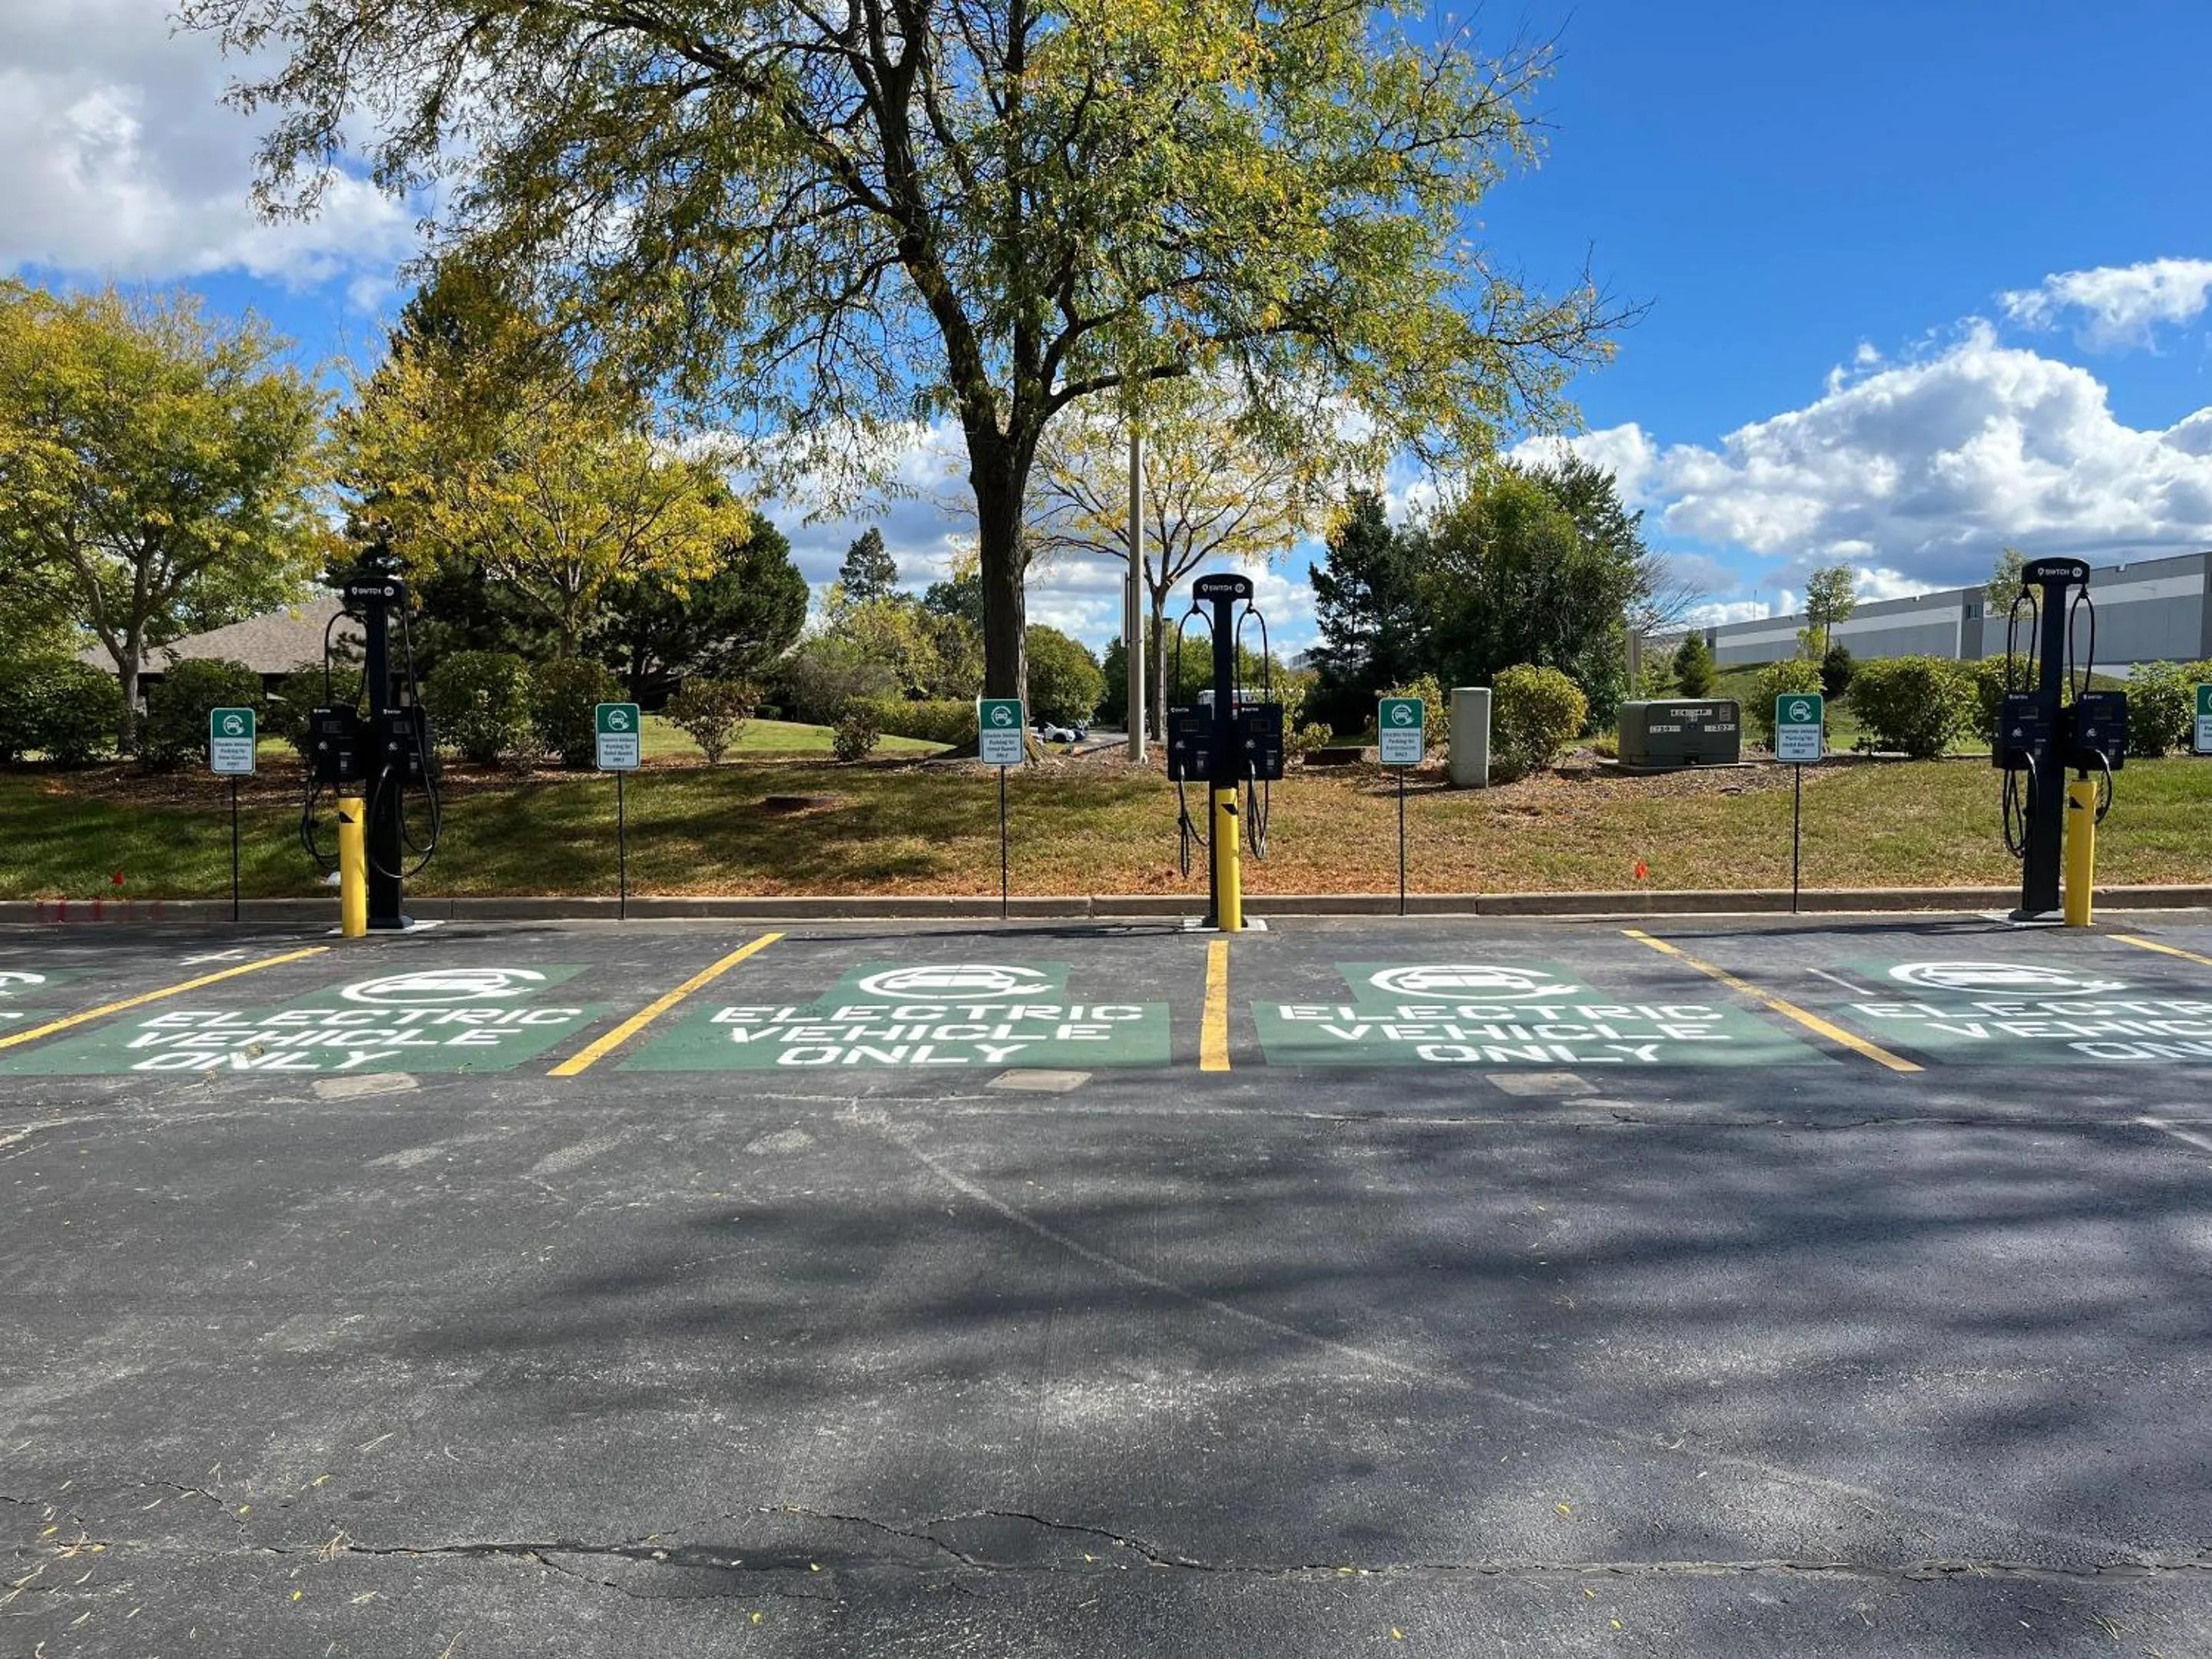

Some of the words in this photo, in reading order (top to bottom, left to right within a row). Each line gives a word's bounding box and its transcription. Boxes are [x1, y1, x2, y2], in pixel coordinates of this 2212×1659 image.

[137, 1009, 584, 1027] ELECTRIC
[710, 1005, 1143, 1022] ELECTRIC
[1279, 1005, 1724, 1022] ELECTRIC
[126, 1028, 524, 1048] VEHICLE
[730, 1024, 1113, 1043] VEHICLE
[1317, 1024, 1734, 1041] VEHICLE
[1924, 1020, 2212, 1038] VEHIC
[129, 1051, 403, 1070] ONLY
[775, 1044, 1029, 1066] ONLY
[1415, 1043, 1661, 1063] ONLY
